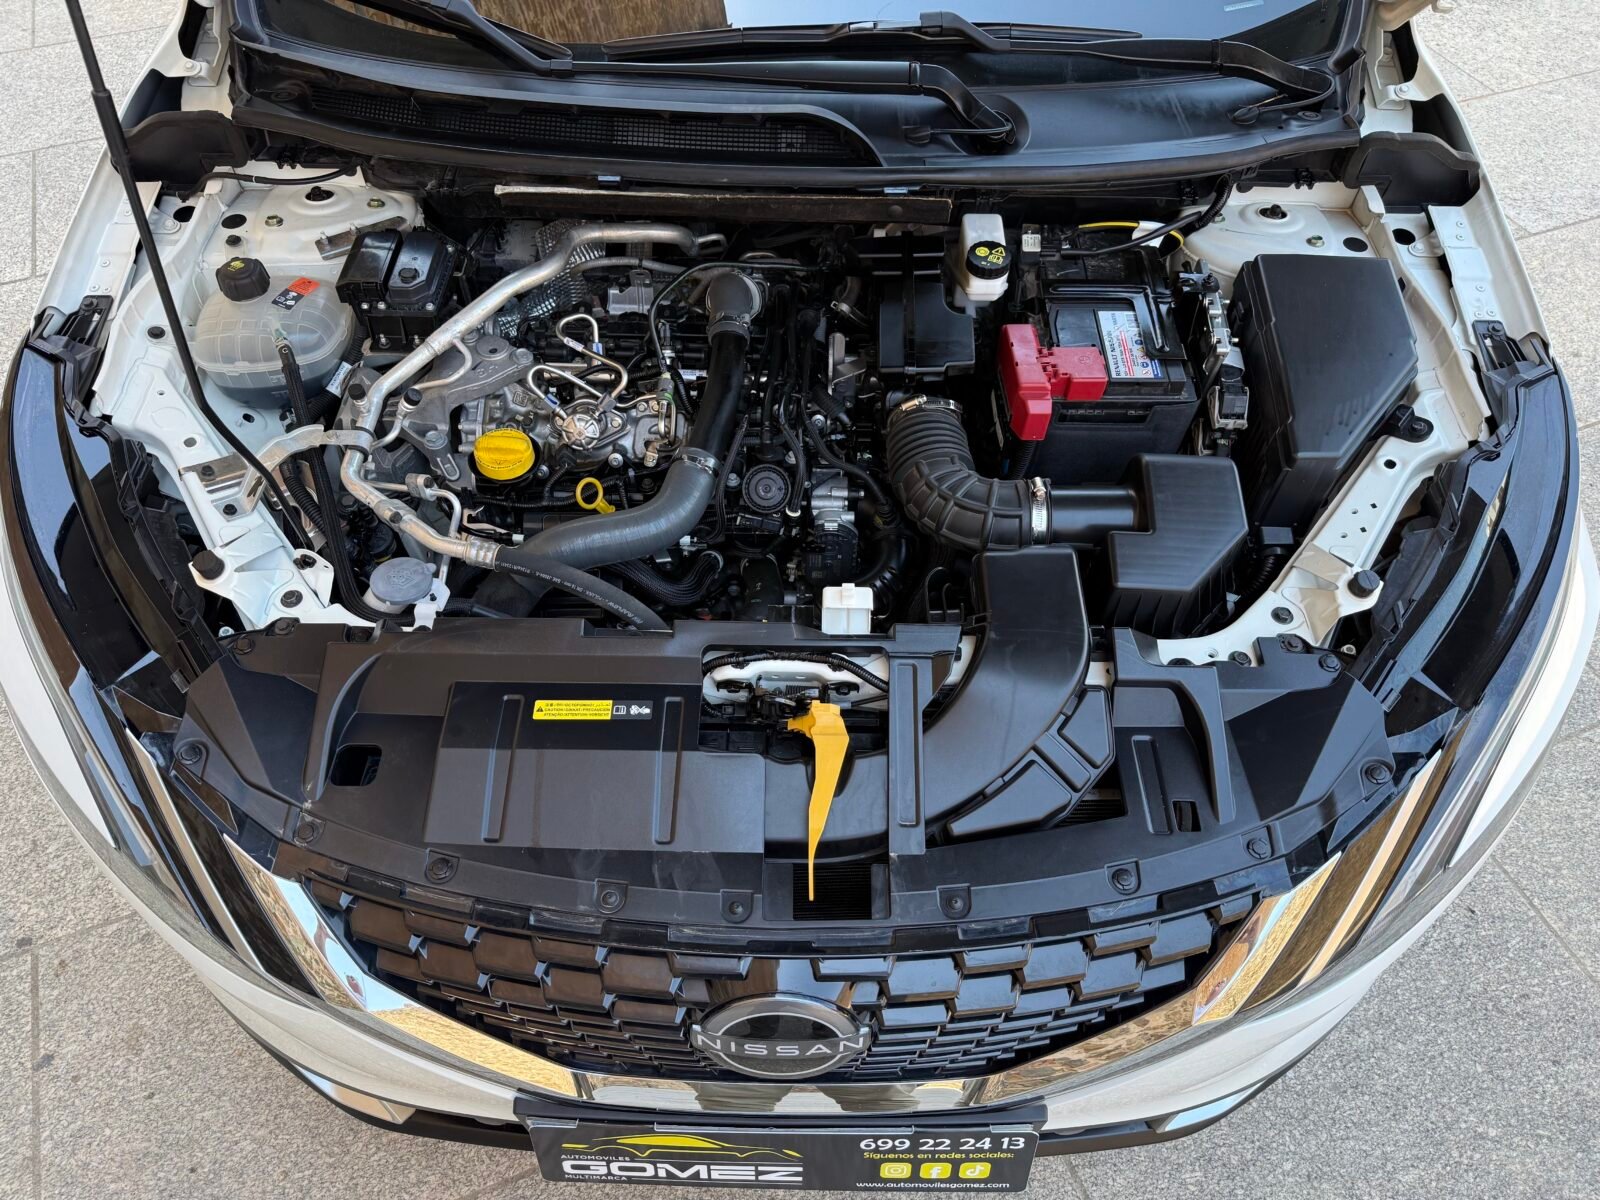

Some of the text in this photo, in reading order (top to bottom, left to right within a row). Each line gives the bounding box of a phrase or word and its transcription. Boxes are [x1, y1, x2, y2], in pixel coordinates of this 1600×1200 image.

[1111, 353, 1121, 376] RENAULT
[697, 1034, 863, 1056] NISSAN
[860, 1136, 1025, 1151] 699 22 24 13
[561, 1154, 630, 1162] AUTOMOVILES
[935, 1151, 966, 1159] redes
[969, 1151, 1014, 1159] sociales:
[562, 1160, 803, 1181] GOMEZ
[856, 1181, 1010, 1189] www.automovilesgomez.com
